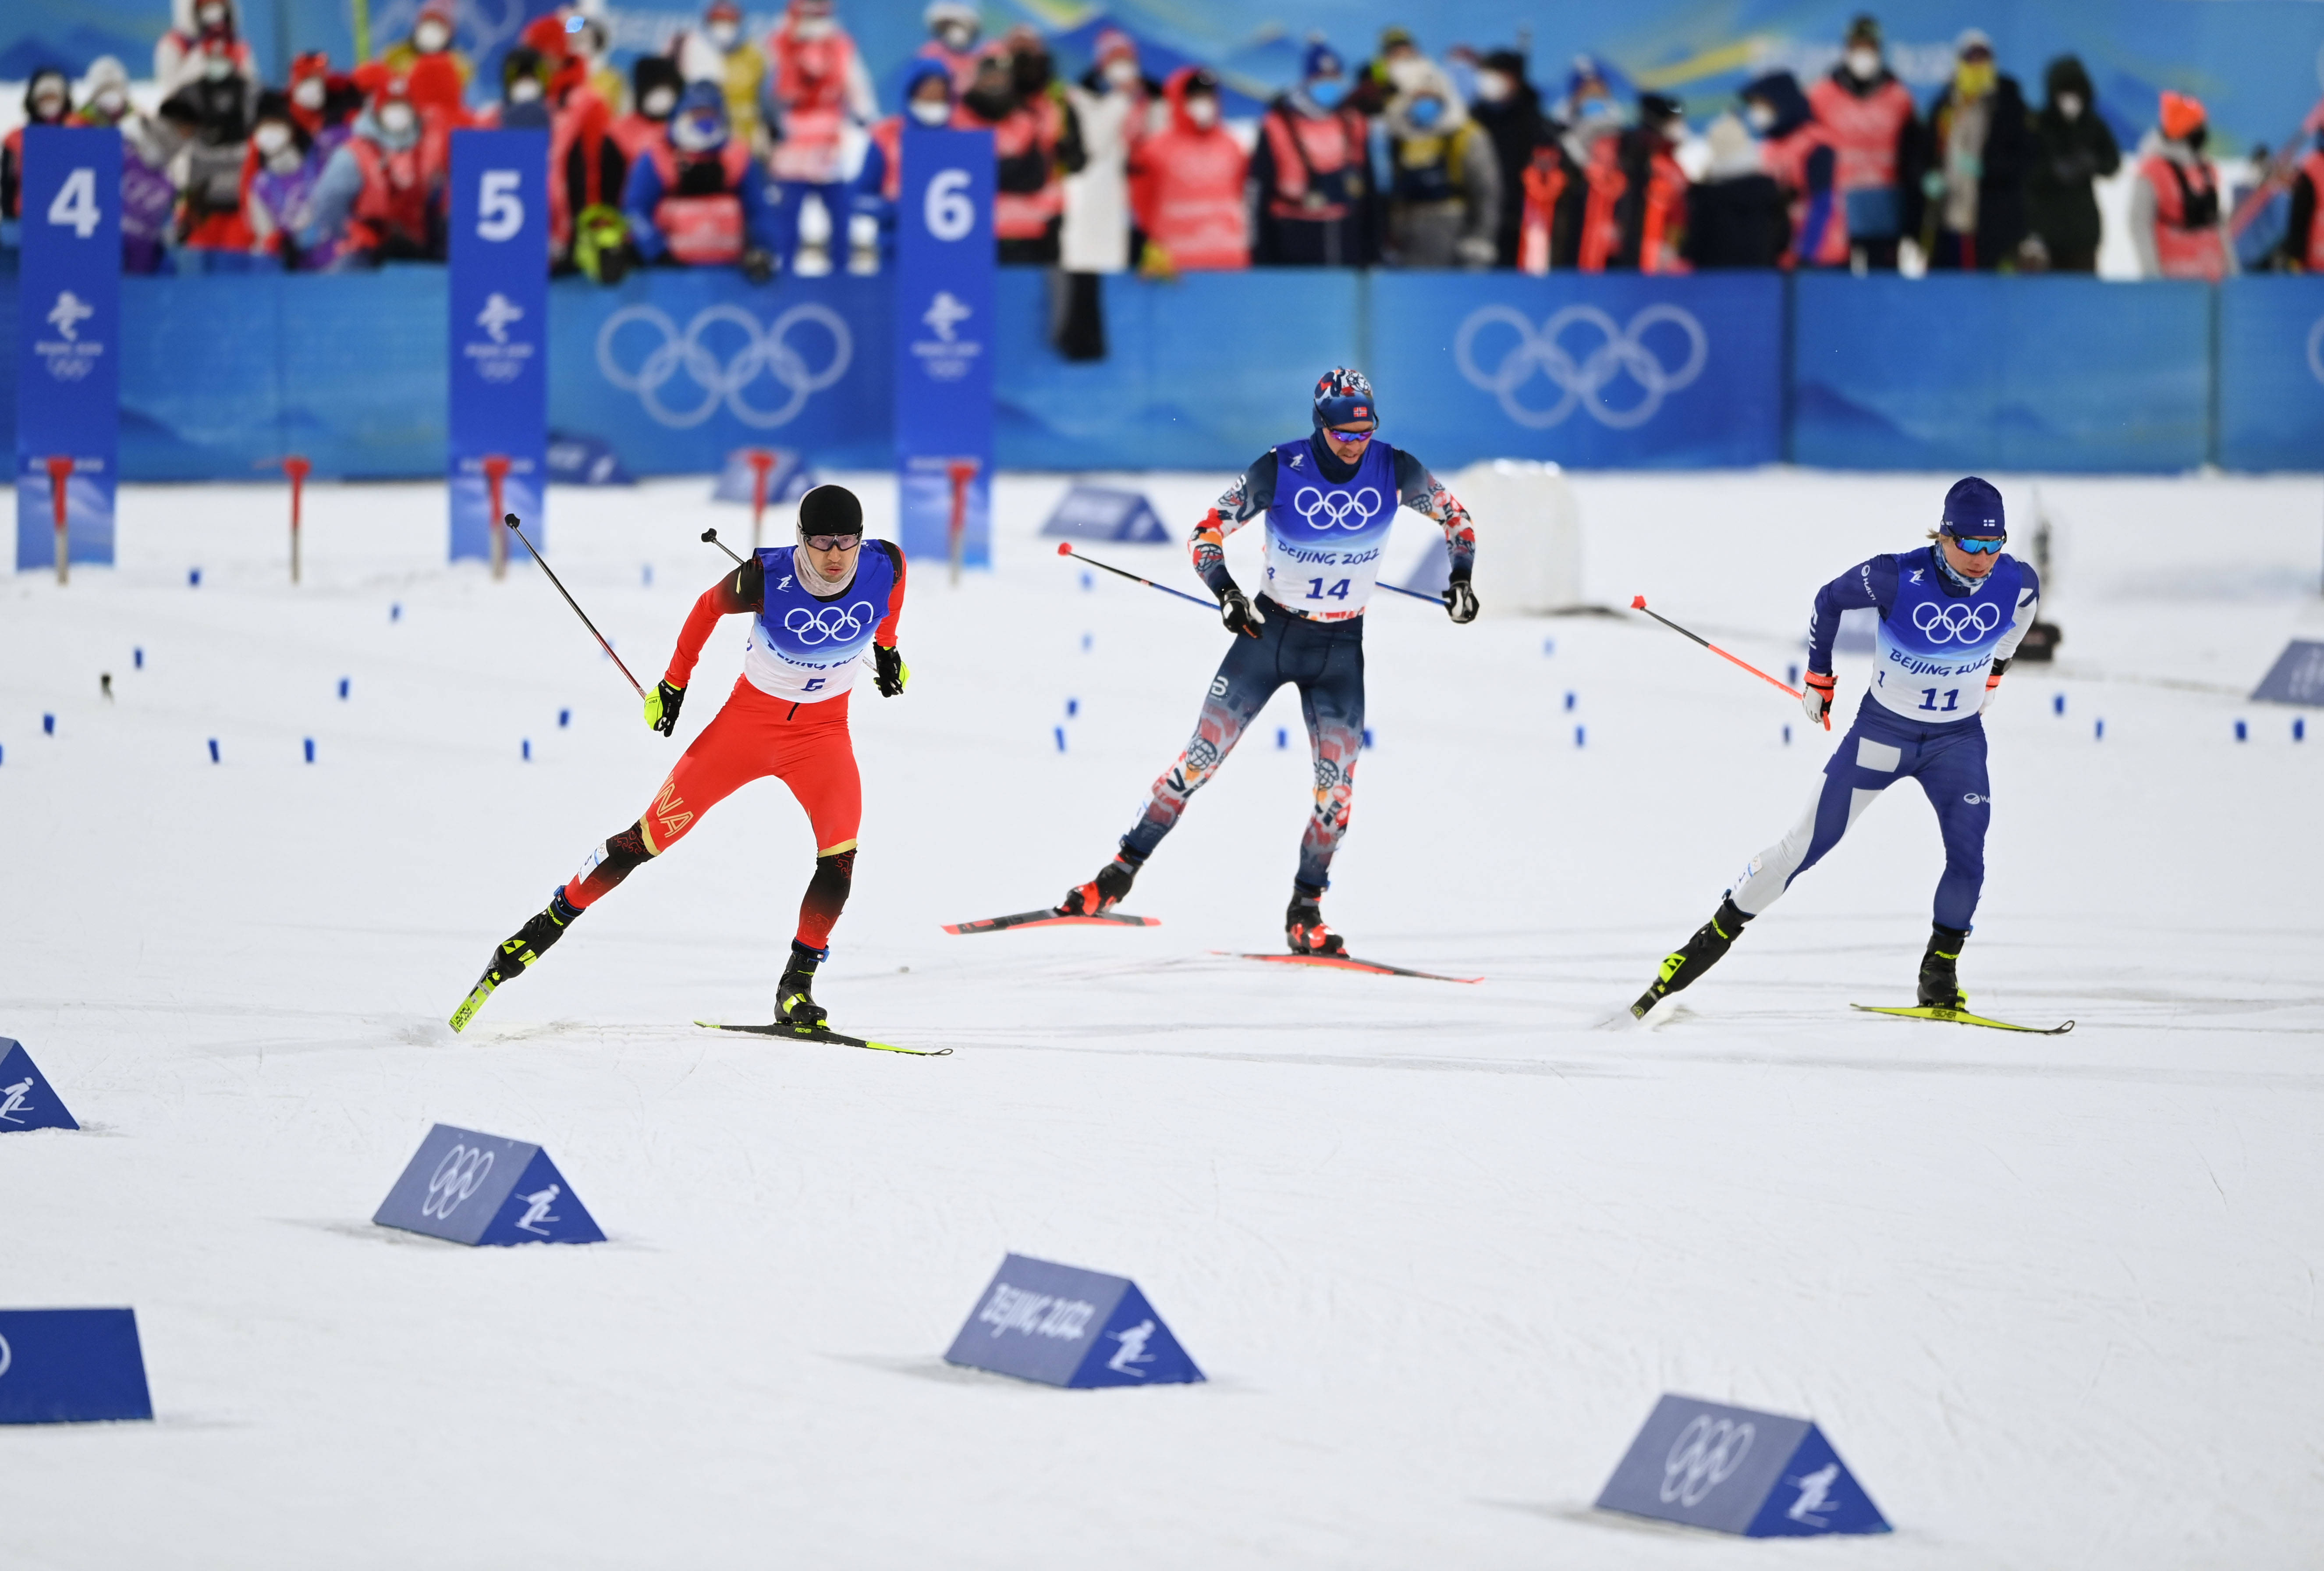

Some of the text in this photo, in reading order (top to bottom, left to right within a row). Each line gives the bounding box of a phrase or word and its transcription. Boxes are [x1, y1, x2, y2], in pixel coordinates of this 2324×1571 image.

[48, 168, 101, 238] 4
[477, 169, 524, 242] 5
[924, 168, 976, 242] 6
[1277, 539, 1337, 566] BEIJING
[1305, 577, 1351, 601] 14
[1863, 577, 1877, 601] HALTI
[1889, 648, 1952, 677] BEIJING
[1918, 688, 1959, 711] 11
[654, 771, 694, 838] INA
[1930, 1009, 1957, 1019] FISCHER
